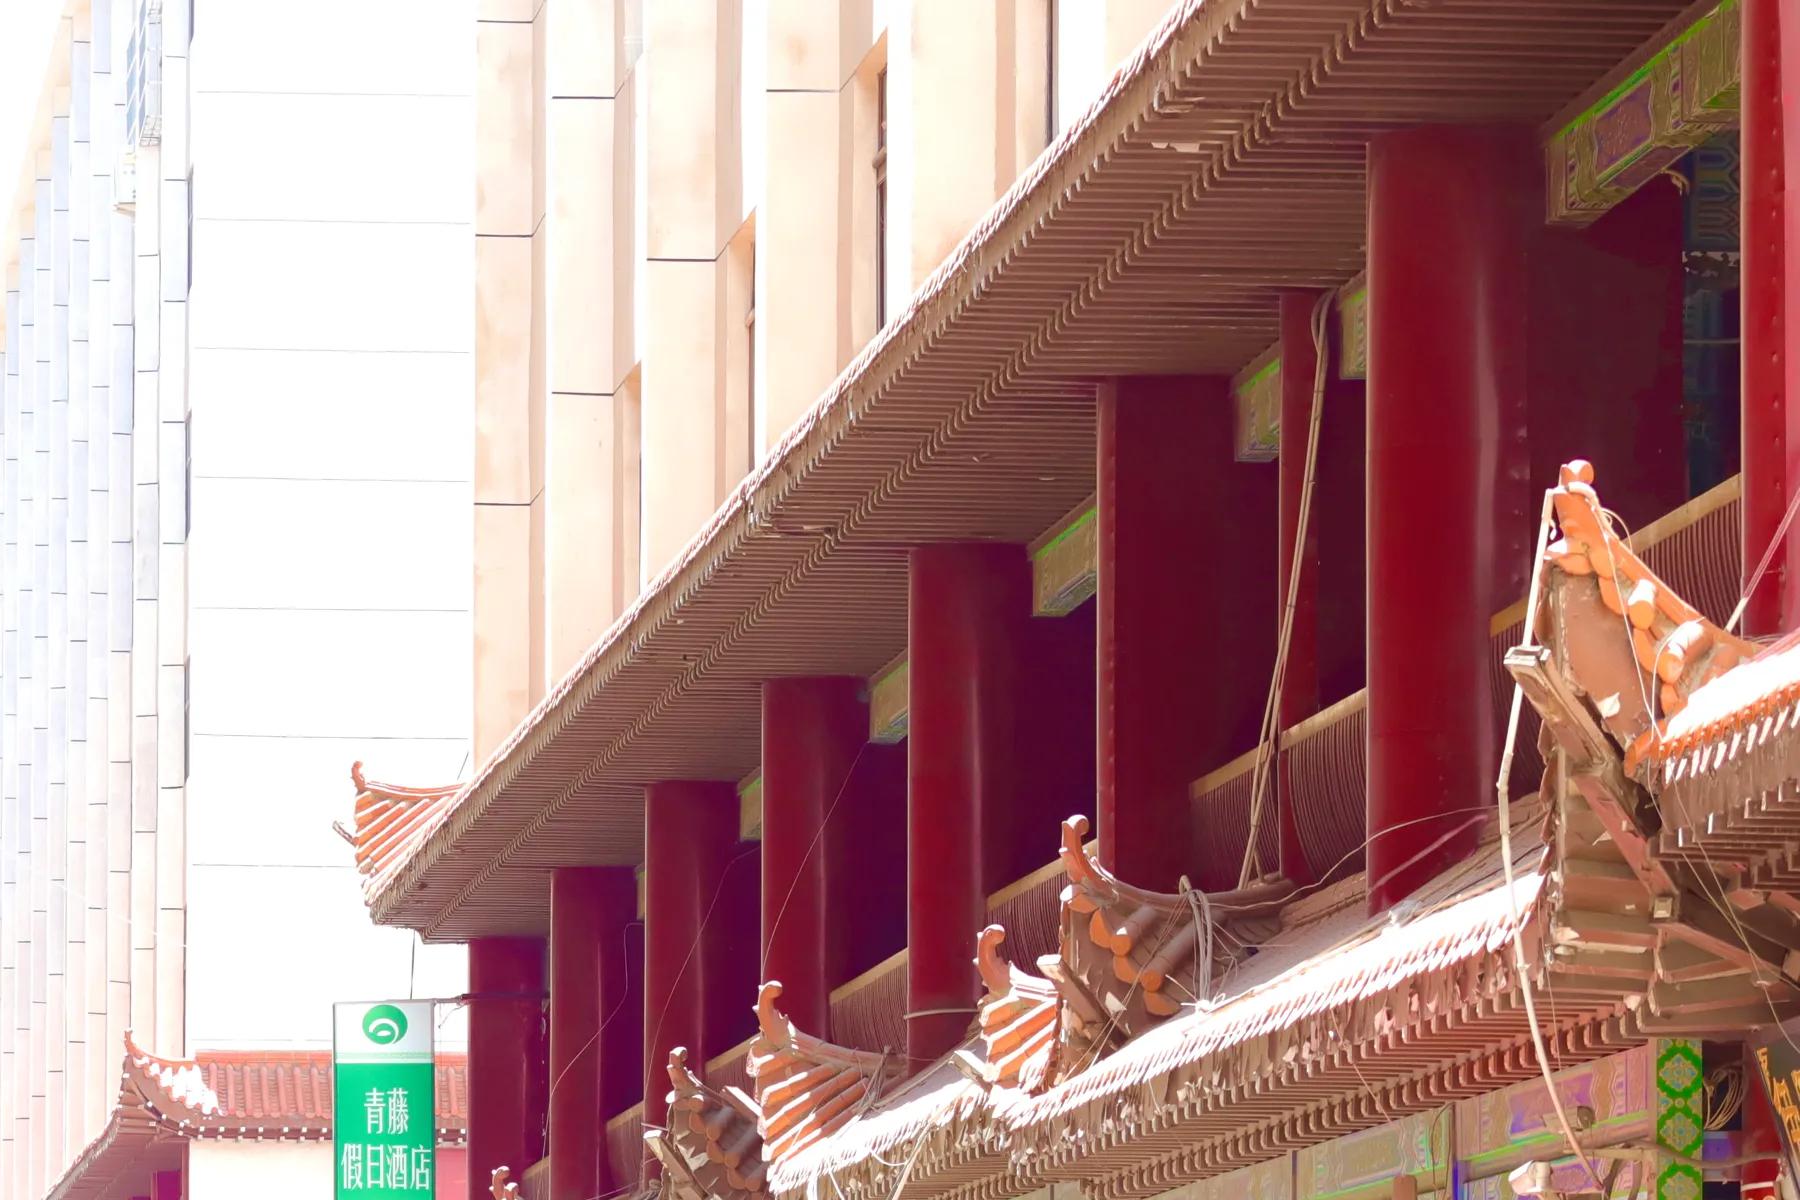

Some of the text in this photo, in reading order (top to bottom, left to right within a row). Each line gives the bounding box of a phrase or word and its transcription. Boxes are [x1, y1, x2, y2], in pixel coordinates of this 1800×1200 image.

[364, 1088, 409, 1135] 青藤
[341, 1143, 432, 1190] 假日酒店
